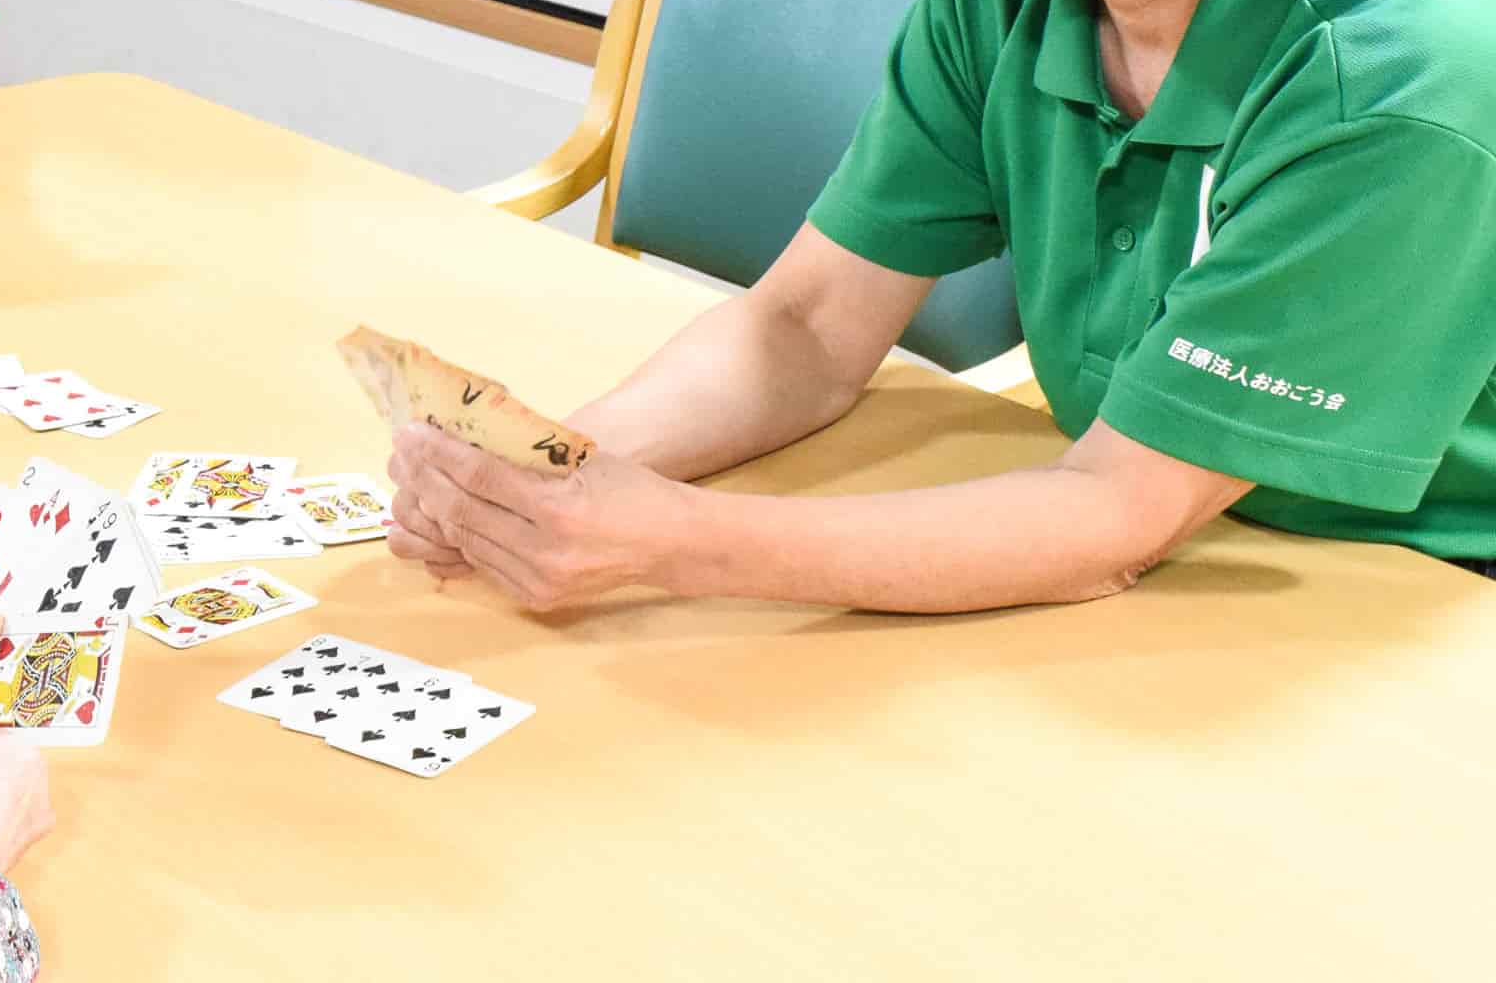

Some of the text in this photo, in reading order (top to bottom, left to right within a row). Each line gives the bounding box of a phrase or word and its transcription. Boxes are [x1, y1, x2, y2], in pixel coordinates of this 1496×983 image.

[1167, 336, 1346, 411] 医療法人おおごう会
[22, 465, 36, 486] 2
